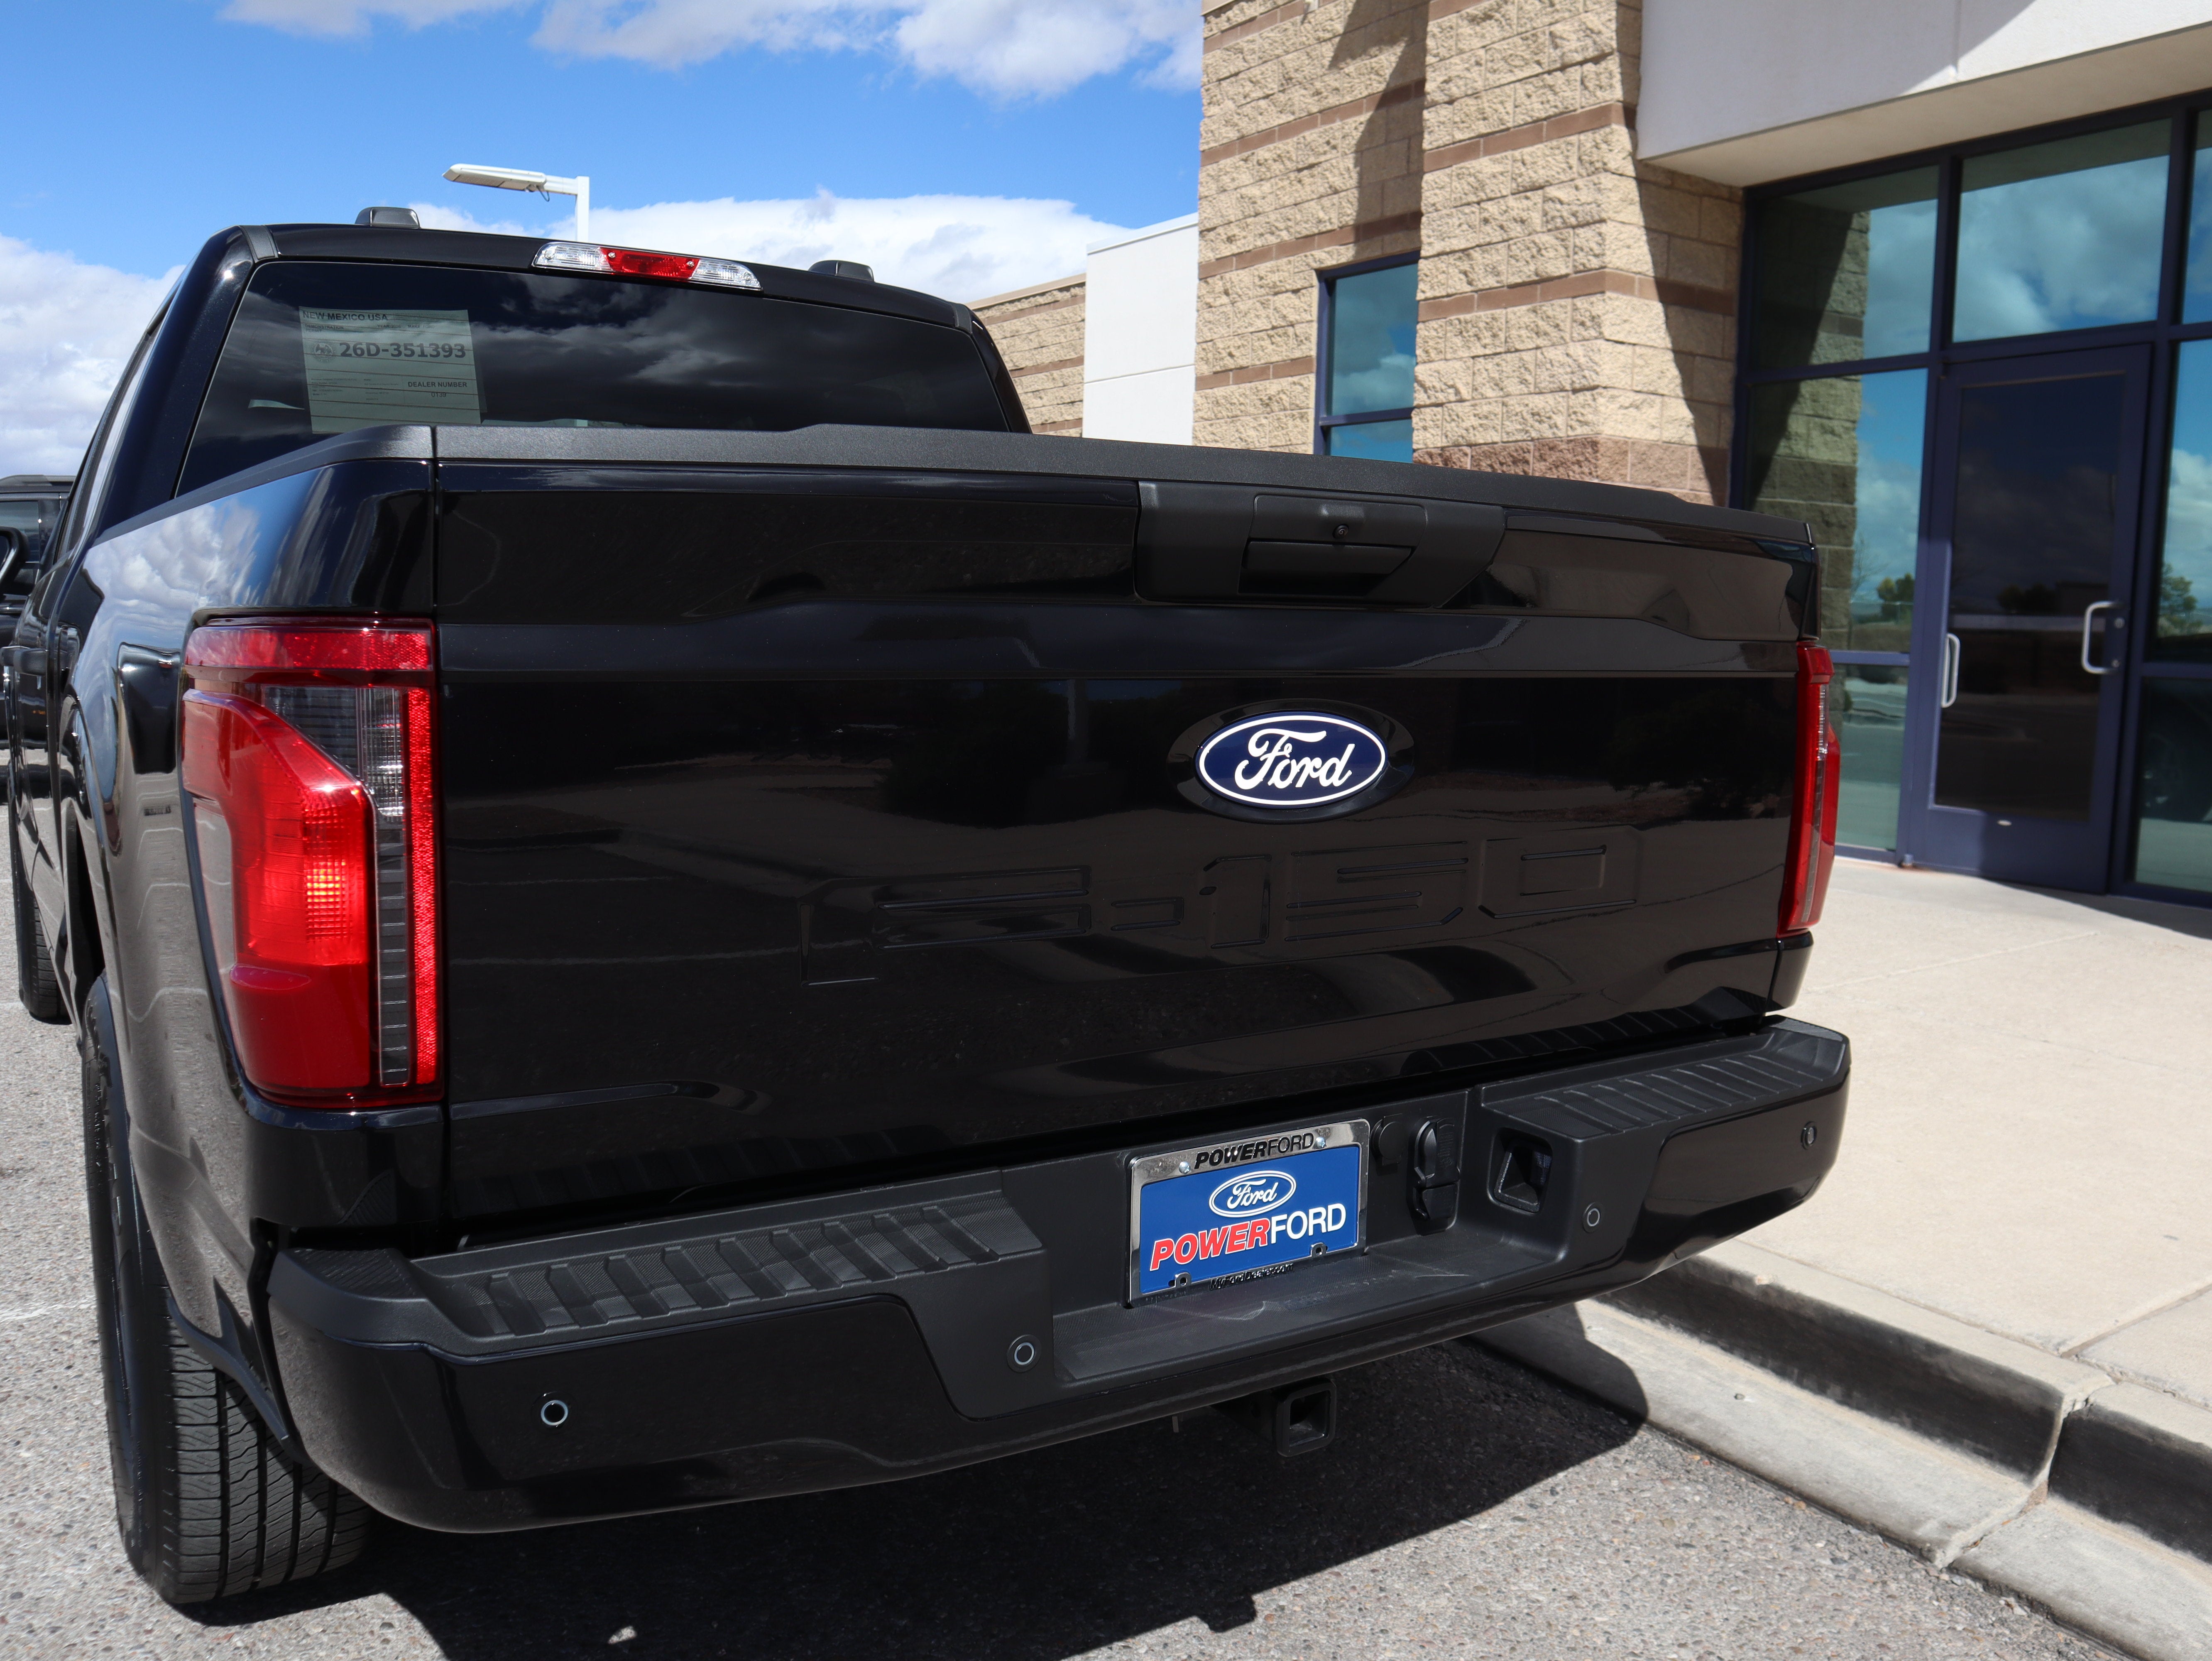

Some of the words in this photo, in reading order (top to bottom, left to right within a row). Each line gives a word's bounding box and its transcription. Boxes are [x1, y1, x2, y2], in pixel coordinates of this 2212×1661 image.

[303, 311, 325, 320] NEW
[328, 313, 365, 321] MEXICO
[339, 342, 466, 358] 26D-351393
[1234, 728, 1356, 790] Ford
[798, 823, 1643, 987] F-150
[1194, 1133, 1314, 1169] POWERFORD
[1226, 1178, 1278, 1209] Ford
[1150, 1203, 1347, 1271] POWERFORD
[1209, 1263, 1295, 1291] MyFordDealer.com
